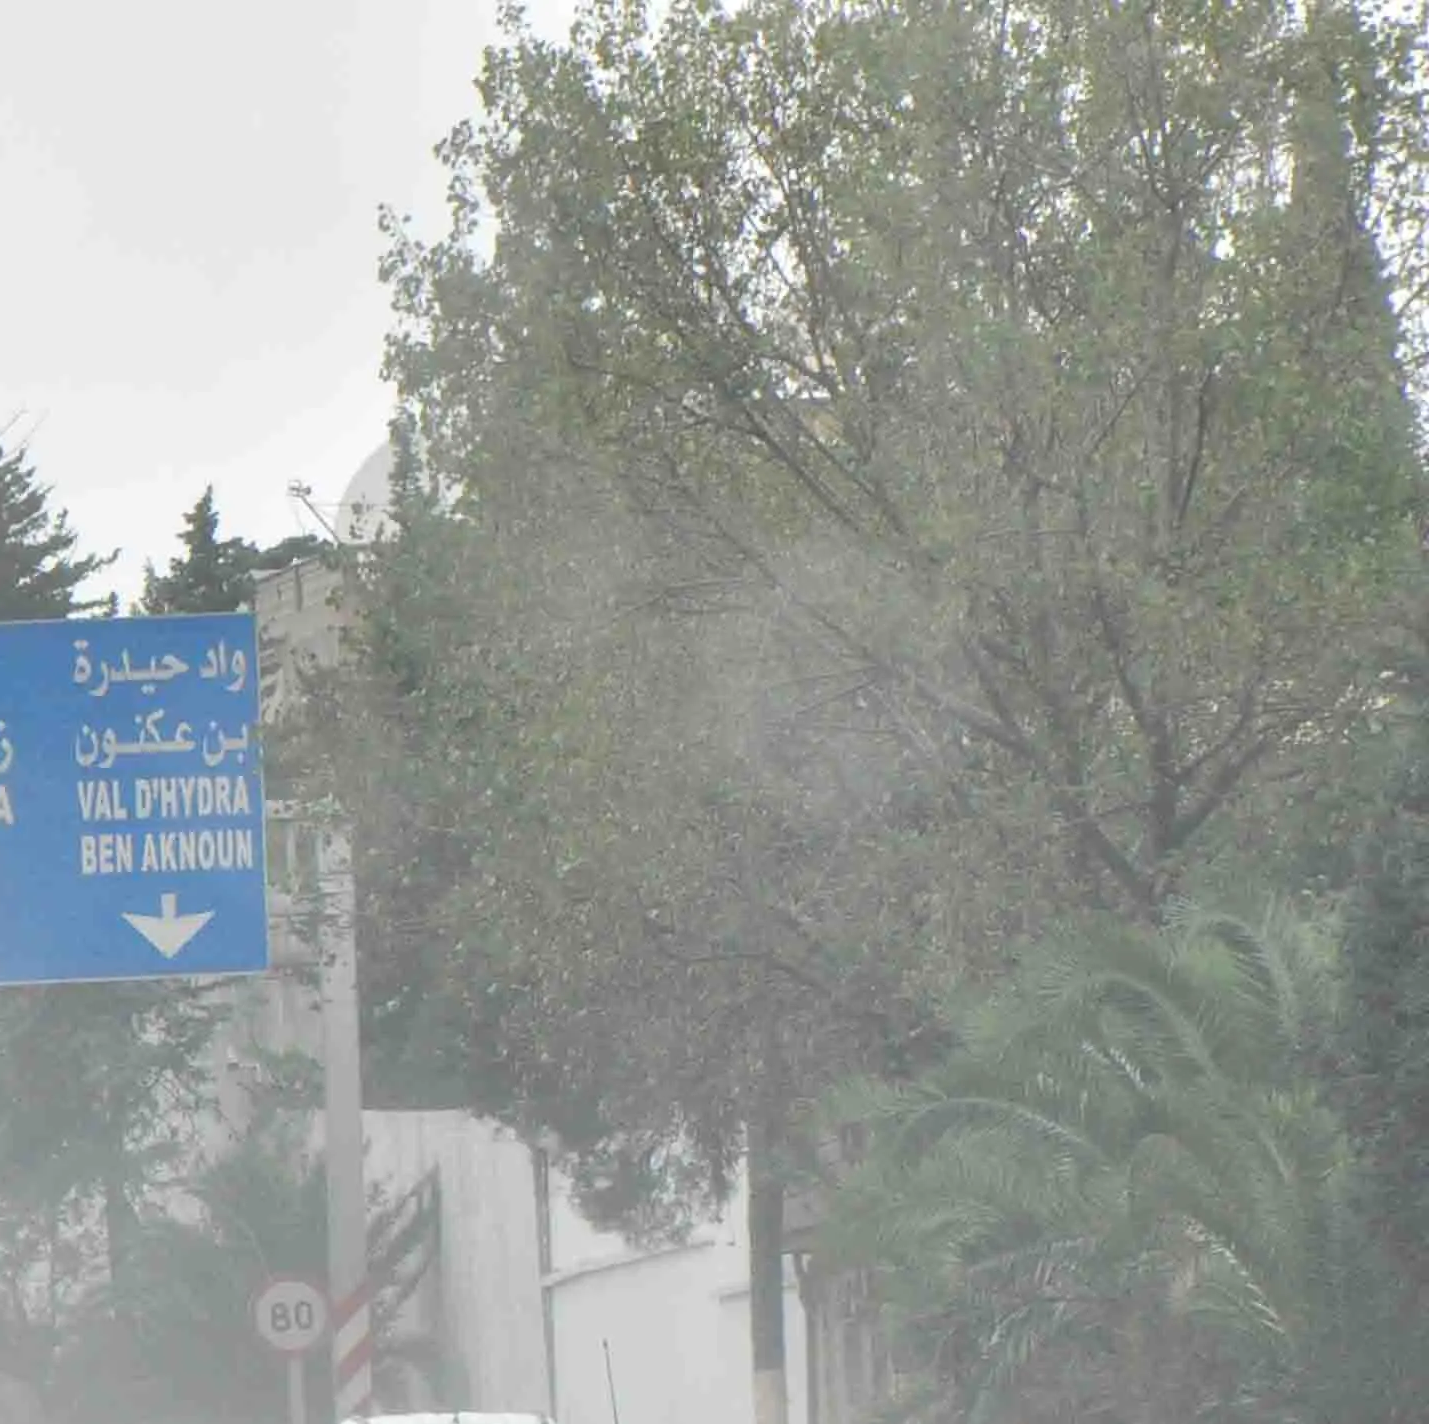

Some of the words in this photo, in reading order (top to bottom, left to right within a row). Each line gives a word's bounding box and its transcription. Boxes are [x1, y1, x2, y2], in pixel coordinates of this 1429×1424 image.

[72, 639, 189, 697] حيدرة
[199, 639, 246, 691] واد
[75, 708, 196, 768] عكنون
[203, 720, 248, 767] بن
[77, 778, 128, 821] VAL
[135, 775, 252, 818] D'HYDRA
[81, 834, 133, 875] BEN
[140, 830, 254, 872] AKNOUN
[270, 1301, 313, 1332] 80
